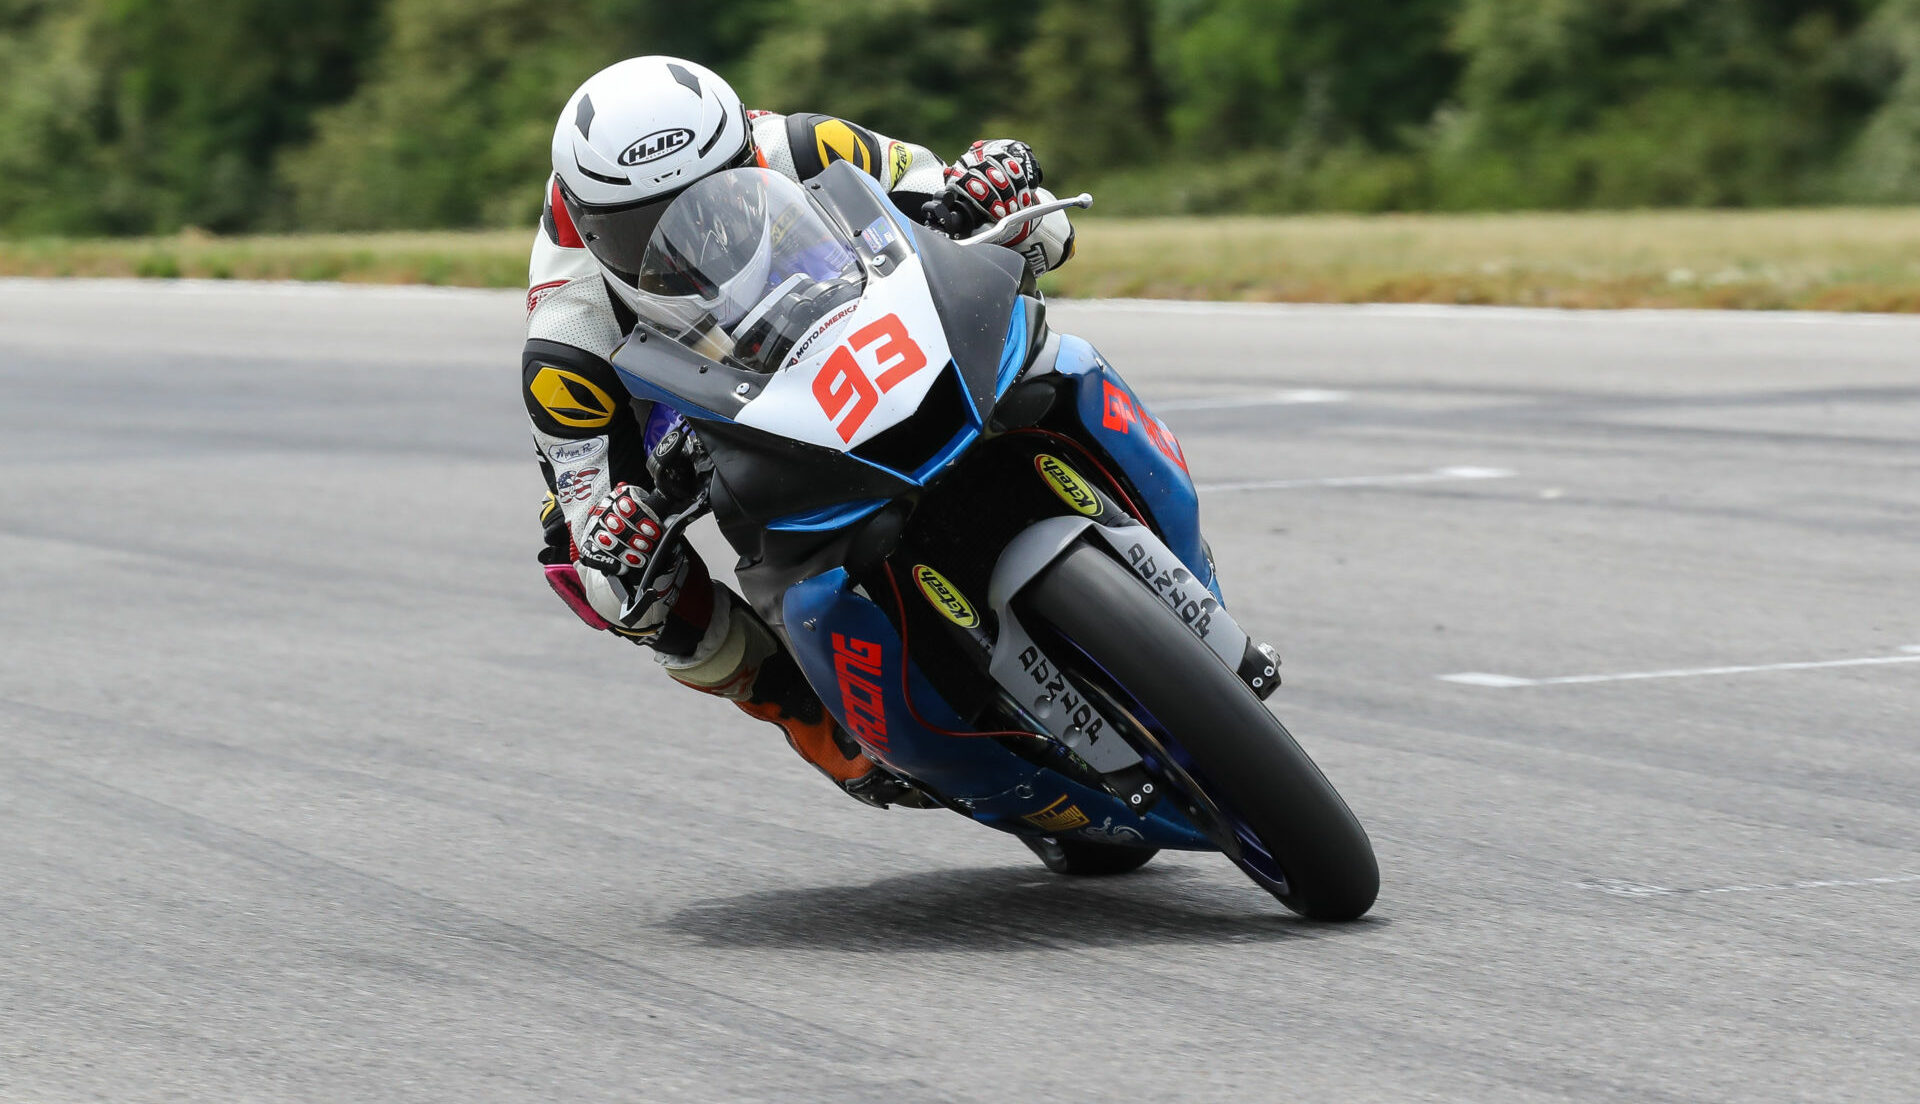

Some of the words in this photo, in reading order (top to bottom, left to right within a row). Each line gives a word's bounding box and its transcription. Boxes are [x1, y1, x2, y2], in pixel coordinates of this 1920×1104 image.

[629, 131, 684, 163] HJC
[797, 304, 859, 358] MOTOAMERICA
[812, 313, 927, 444] 93
[1103, 380, 1137, 434] GP
[1043, 459, 1095, 507] K-tech
[920, 570, 972, 618] K-tech
[1128, 543, 1211, 639] DUNLOP
[831, 632, 891, 753] RACING
[1018, 645, 1103, 746] DUNLOP
